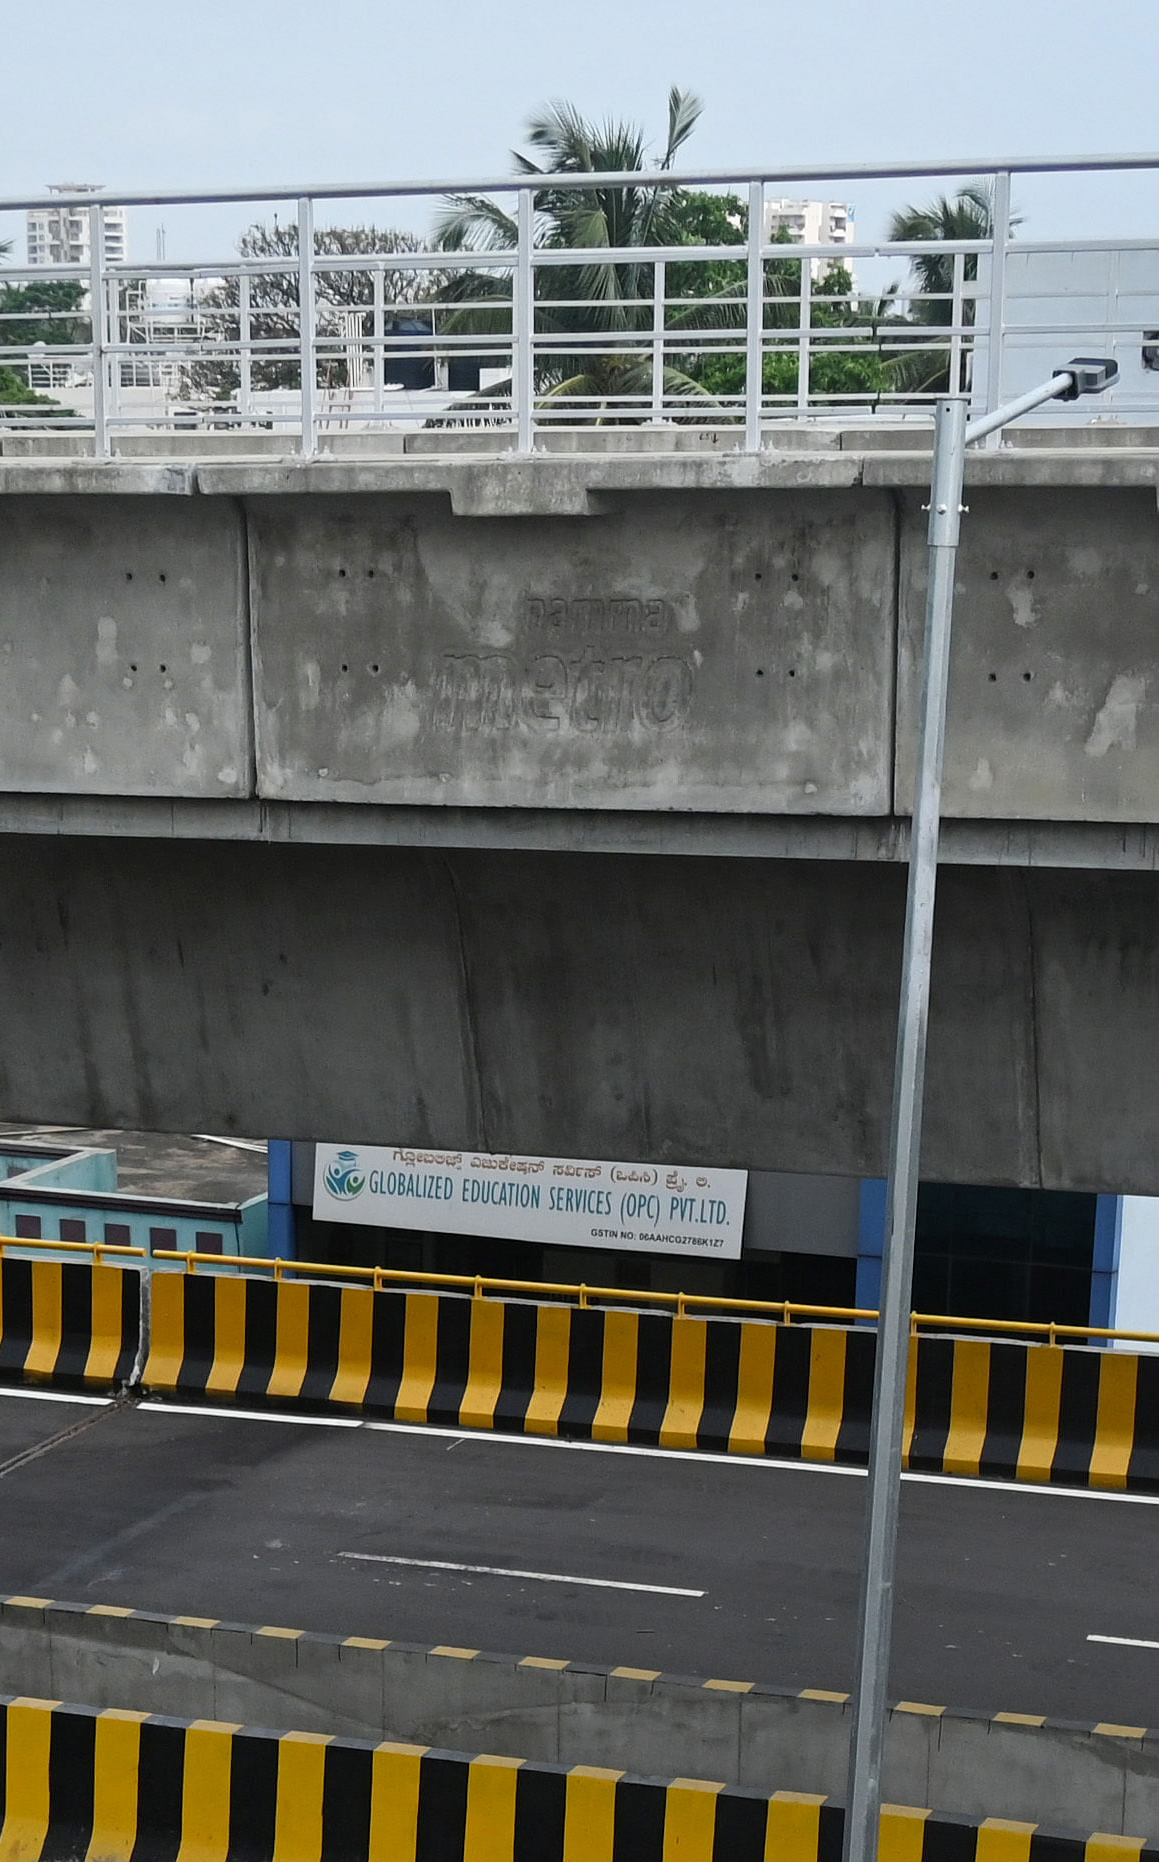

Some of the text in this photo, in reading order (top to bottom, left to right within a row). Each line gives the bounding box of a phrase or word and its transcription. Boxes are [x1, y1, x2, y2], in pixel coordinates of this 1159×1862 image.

[432, 644, 694, 732] metro
[369, 1170, 730, 1227] GLOBALIZED EDUCATION SERVICES (OPC) PVT.LTD.
[591, 1228, 618, 1238] GSTIN
[620, 1231, 636, 1240] NO:
